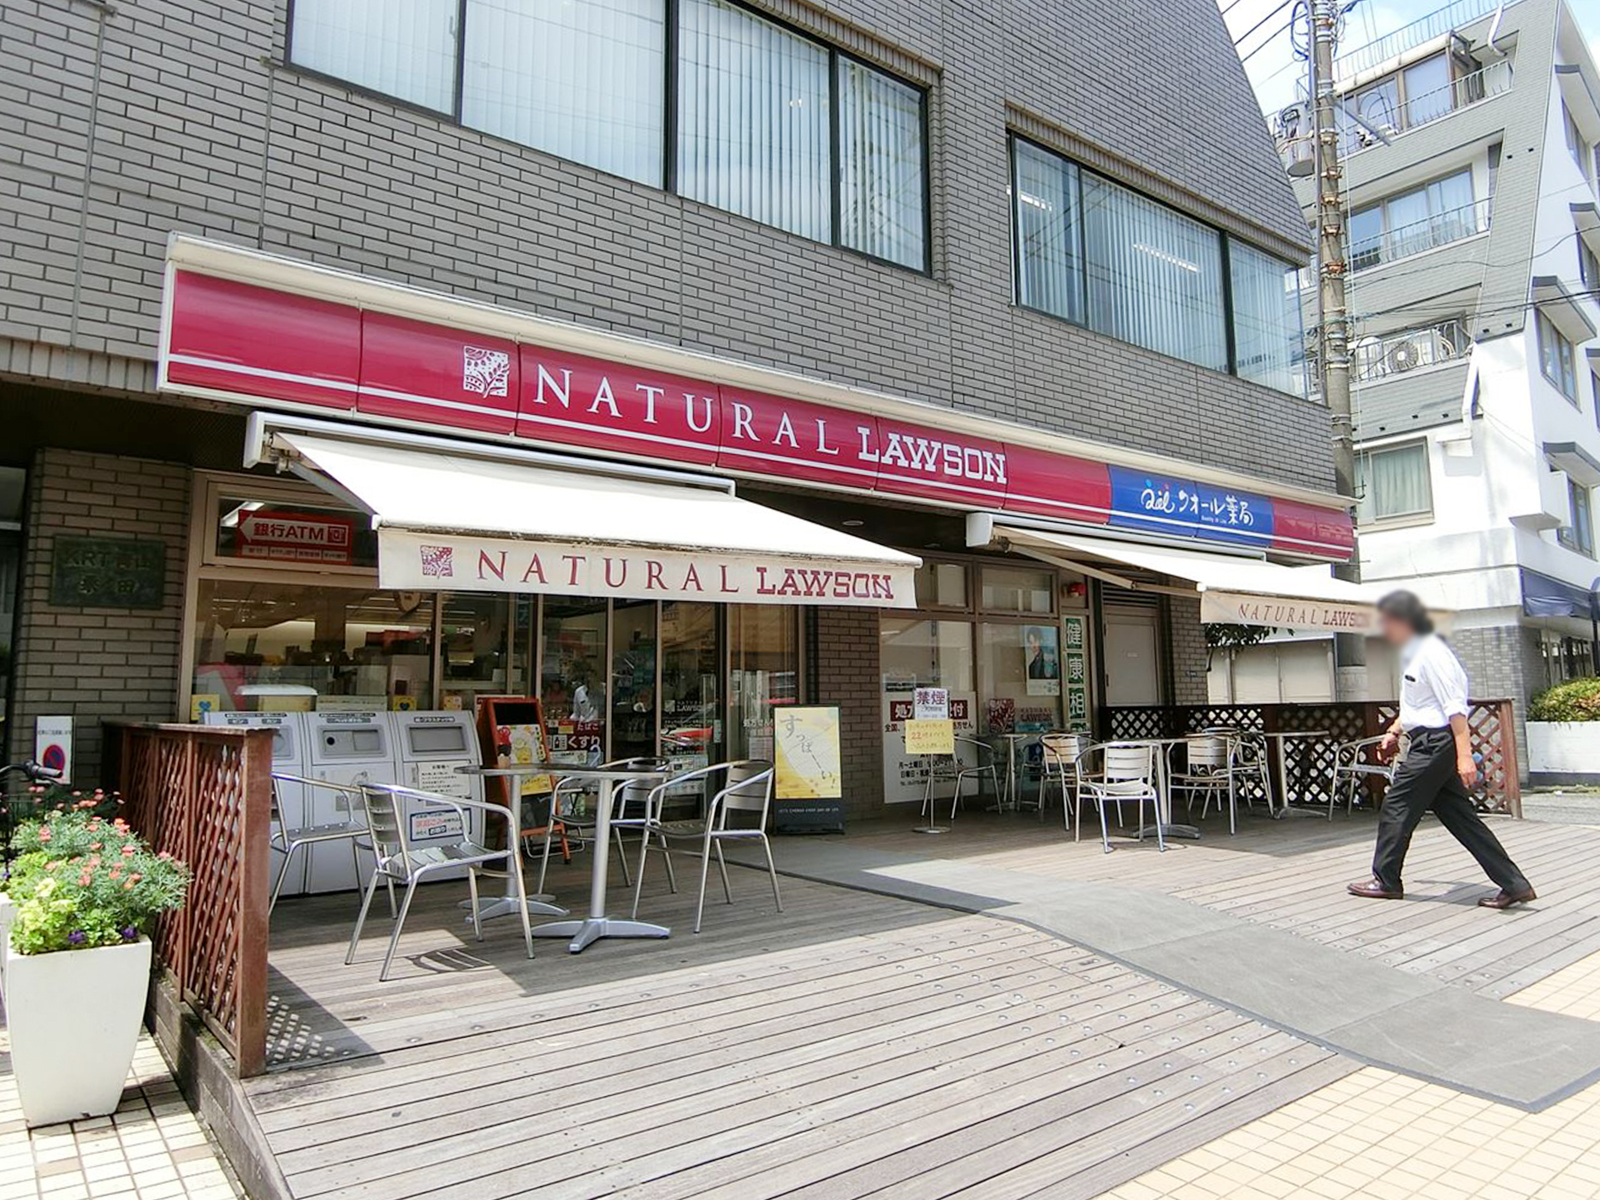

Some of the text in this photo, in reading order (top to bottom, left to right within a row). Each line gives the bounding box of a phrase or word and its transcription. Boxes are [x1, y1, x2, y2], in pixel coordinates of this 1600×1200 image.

[534, 362, 1008, 485] NATURAL LAWSON
[1178, 490, 1254, 526] クオール薬局
[253, 522, 324, 541] 銀行ATM
[478, 549, 894, 600] NATURAL LAWSON
[1238, 603, 1318, 625] NATURAL
[916, 690, 945, 706] 禁煙
[577, 721, 599, 731] たばこ
[568, 735, 601, 749] くすり
